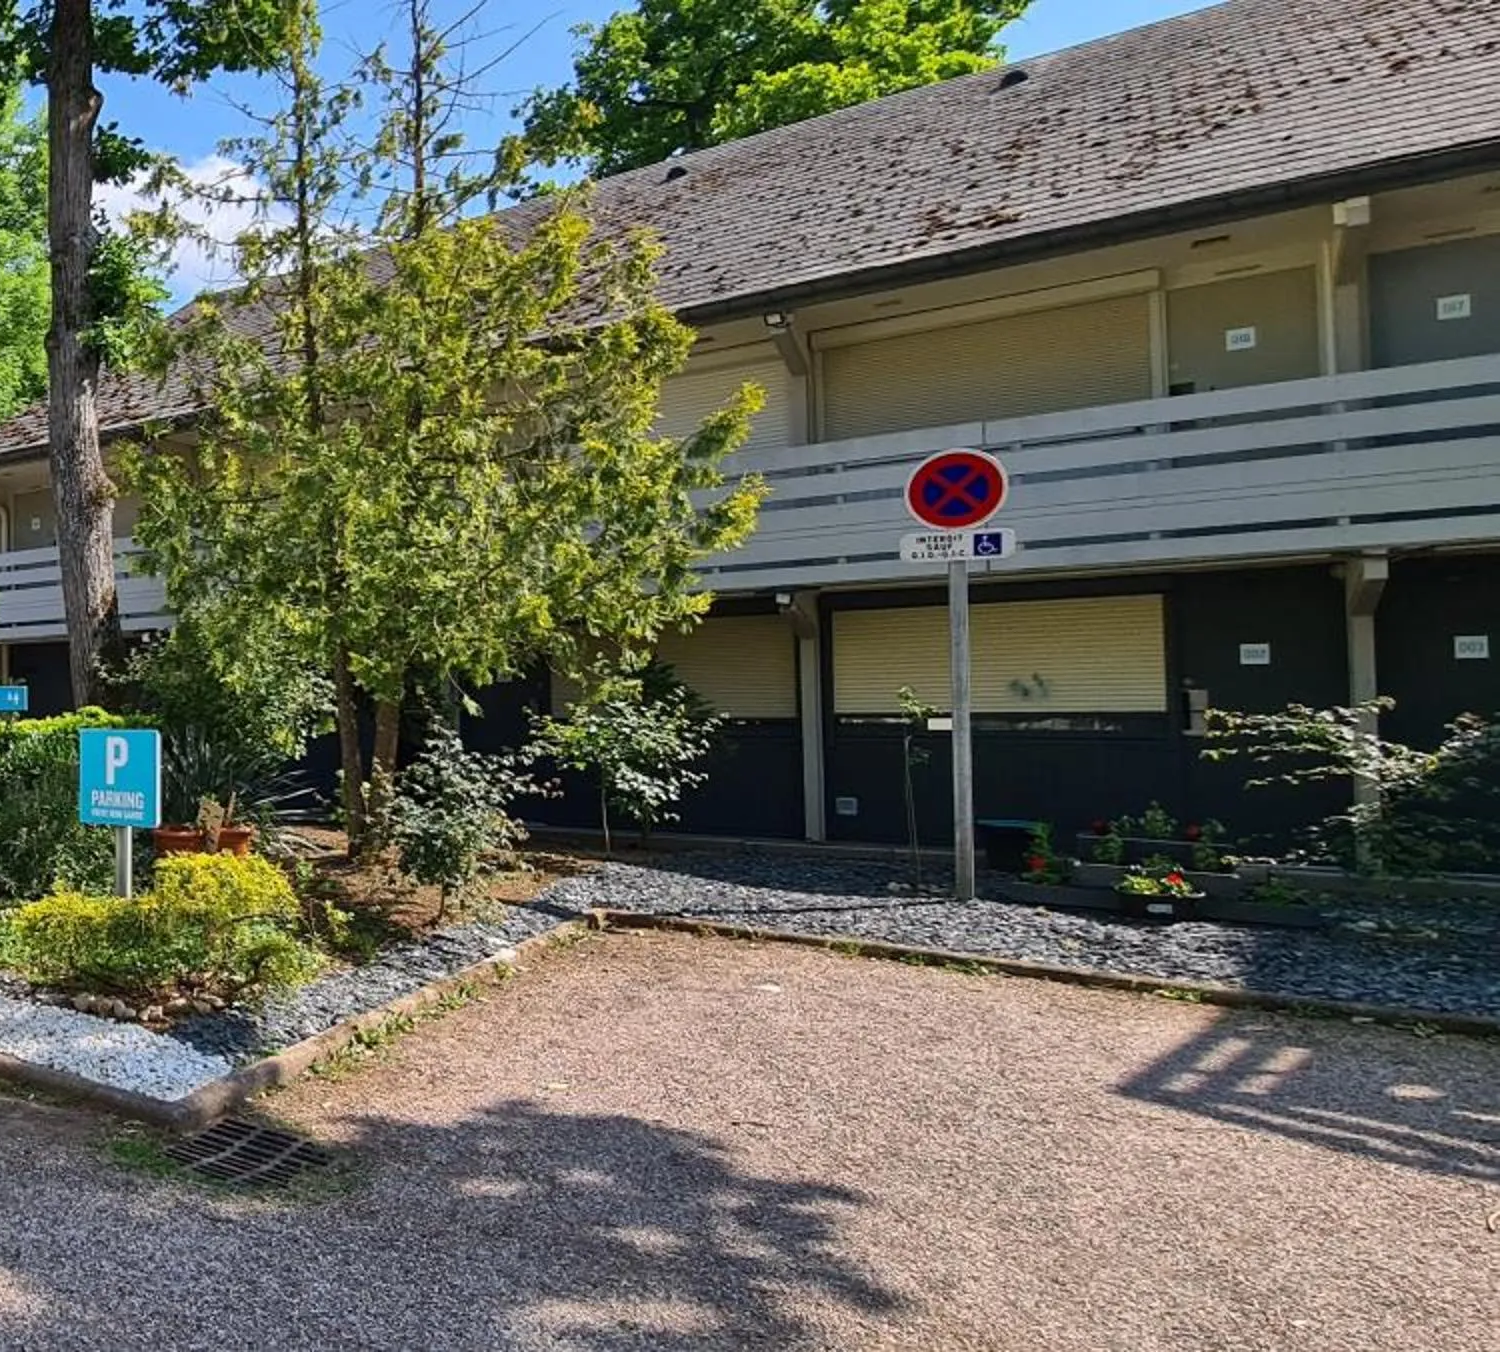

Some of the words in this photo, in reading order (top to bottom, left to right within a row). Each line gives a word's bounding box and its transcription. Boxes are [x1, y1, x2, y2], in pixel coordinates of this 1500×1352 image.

[915, 533, 963, 544] INTERDIT
[926, 543, 953, 551] SAUF
[105, 736, 129, 785] P
[91, 789, 146, 809] PARKING
